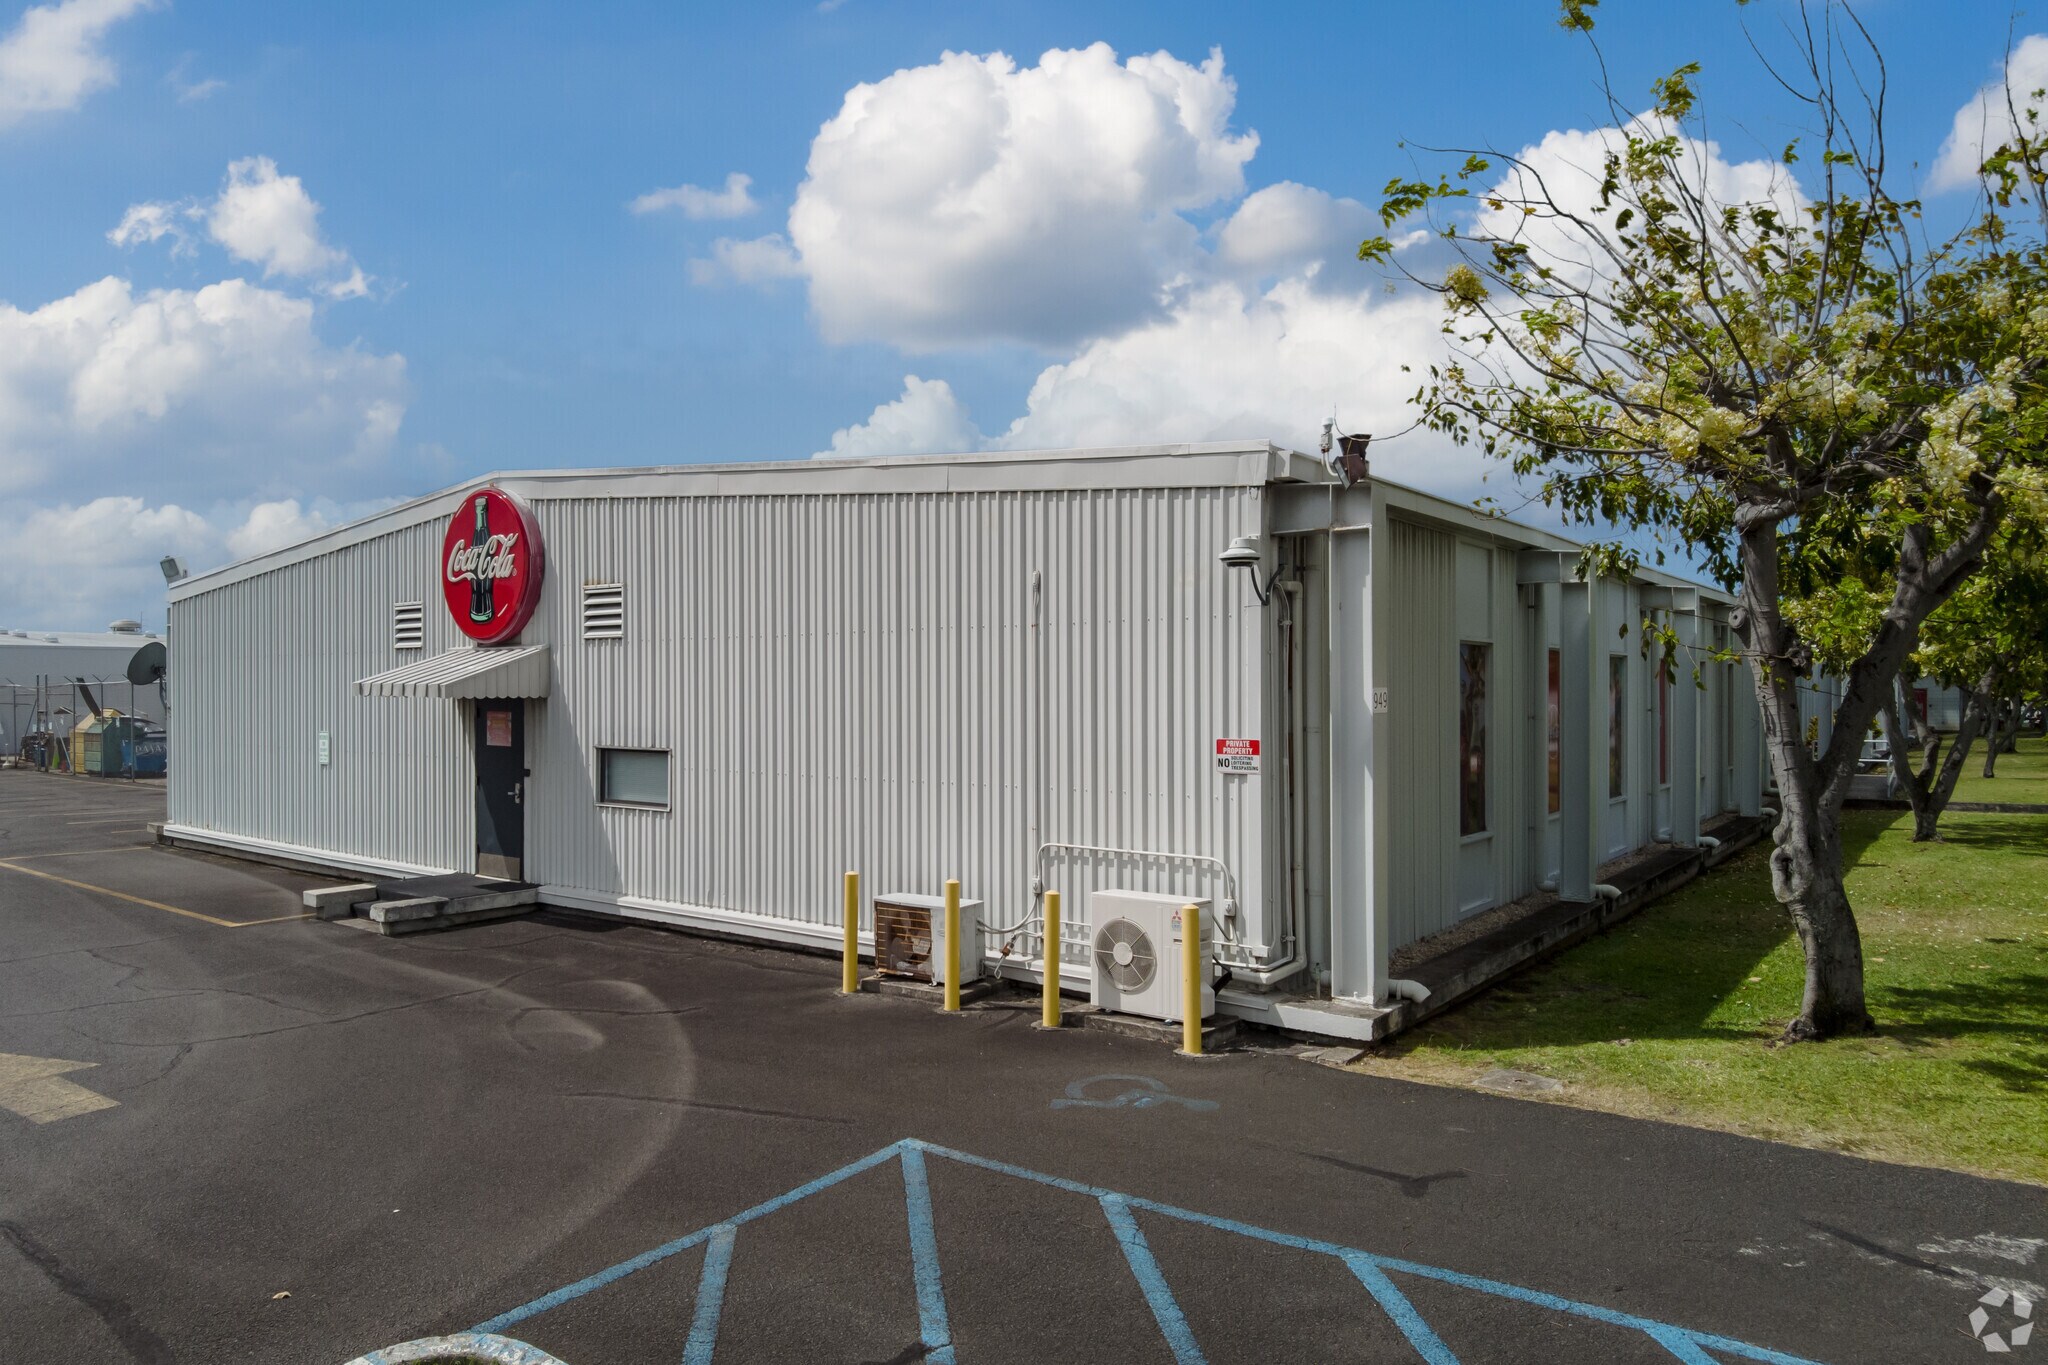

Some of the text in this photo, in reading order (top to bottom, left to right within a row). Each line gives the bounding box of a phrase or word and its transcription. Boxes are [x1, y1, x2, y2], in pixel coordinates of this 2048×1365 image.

[447, 533, 518, 583] Coca-Cola
[1373, 691, 1388, 710] 949
[1225, 740, 1251, 748] PRIVATE
[1222, 747, 1253, 755] PROPERTY
[1217, 758, 1230, 768] NO
